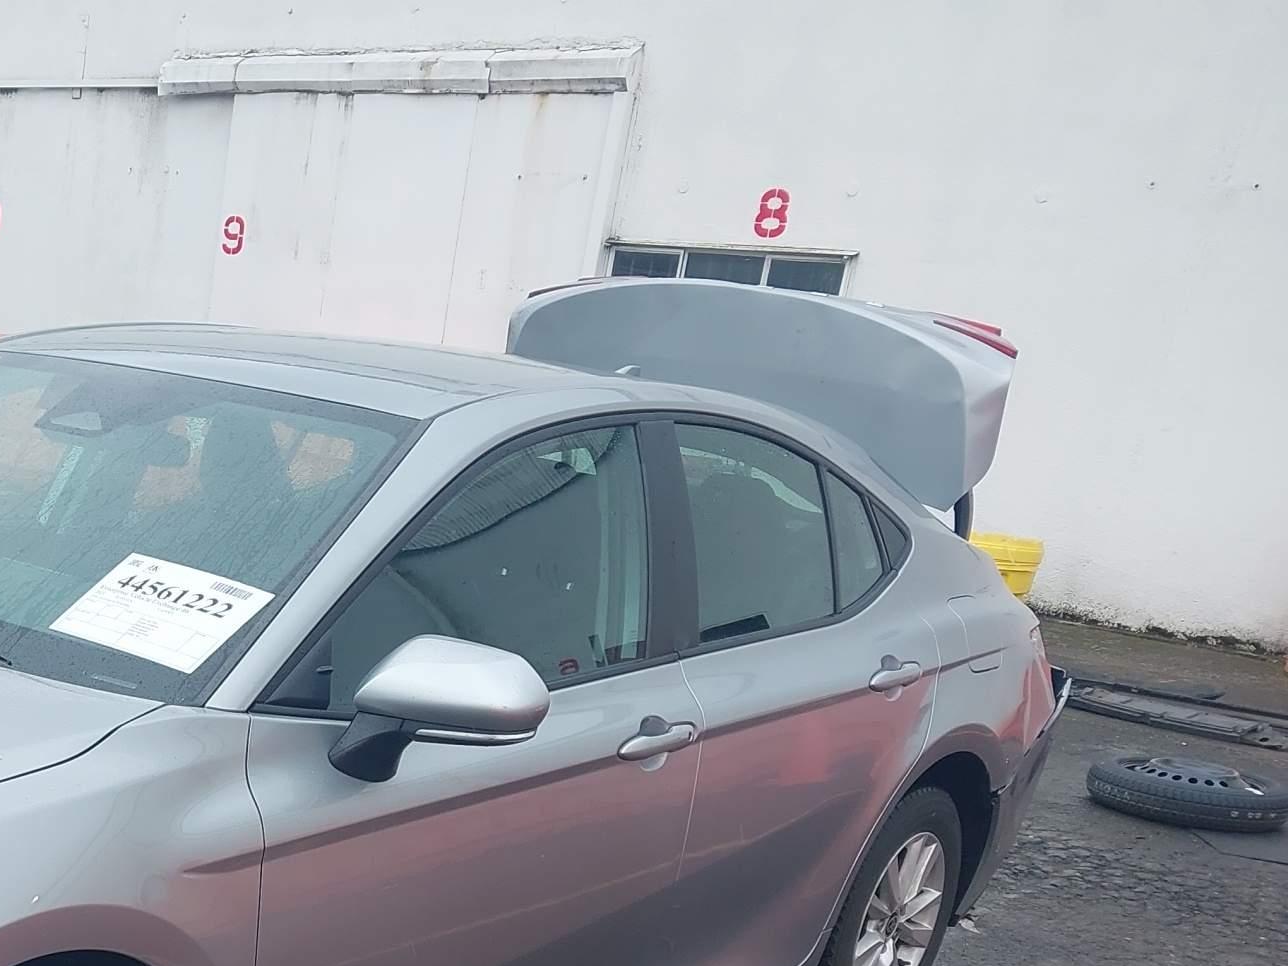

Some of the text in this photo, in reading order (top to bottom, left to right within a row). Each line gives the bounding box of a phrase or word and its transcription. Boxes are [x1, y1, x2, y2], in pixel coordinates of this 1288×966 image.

[222, 215, 245, 255] 9
[753, 188, 790, 239] 8
[117, 574, 234, 619] 44561222
